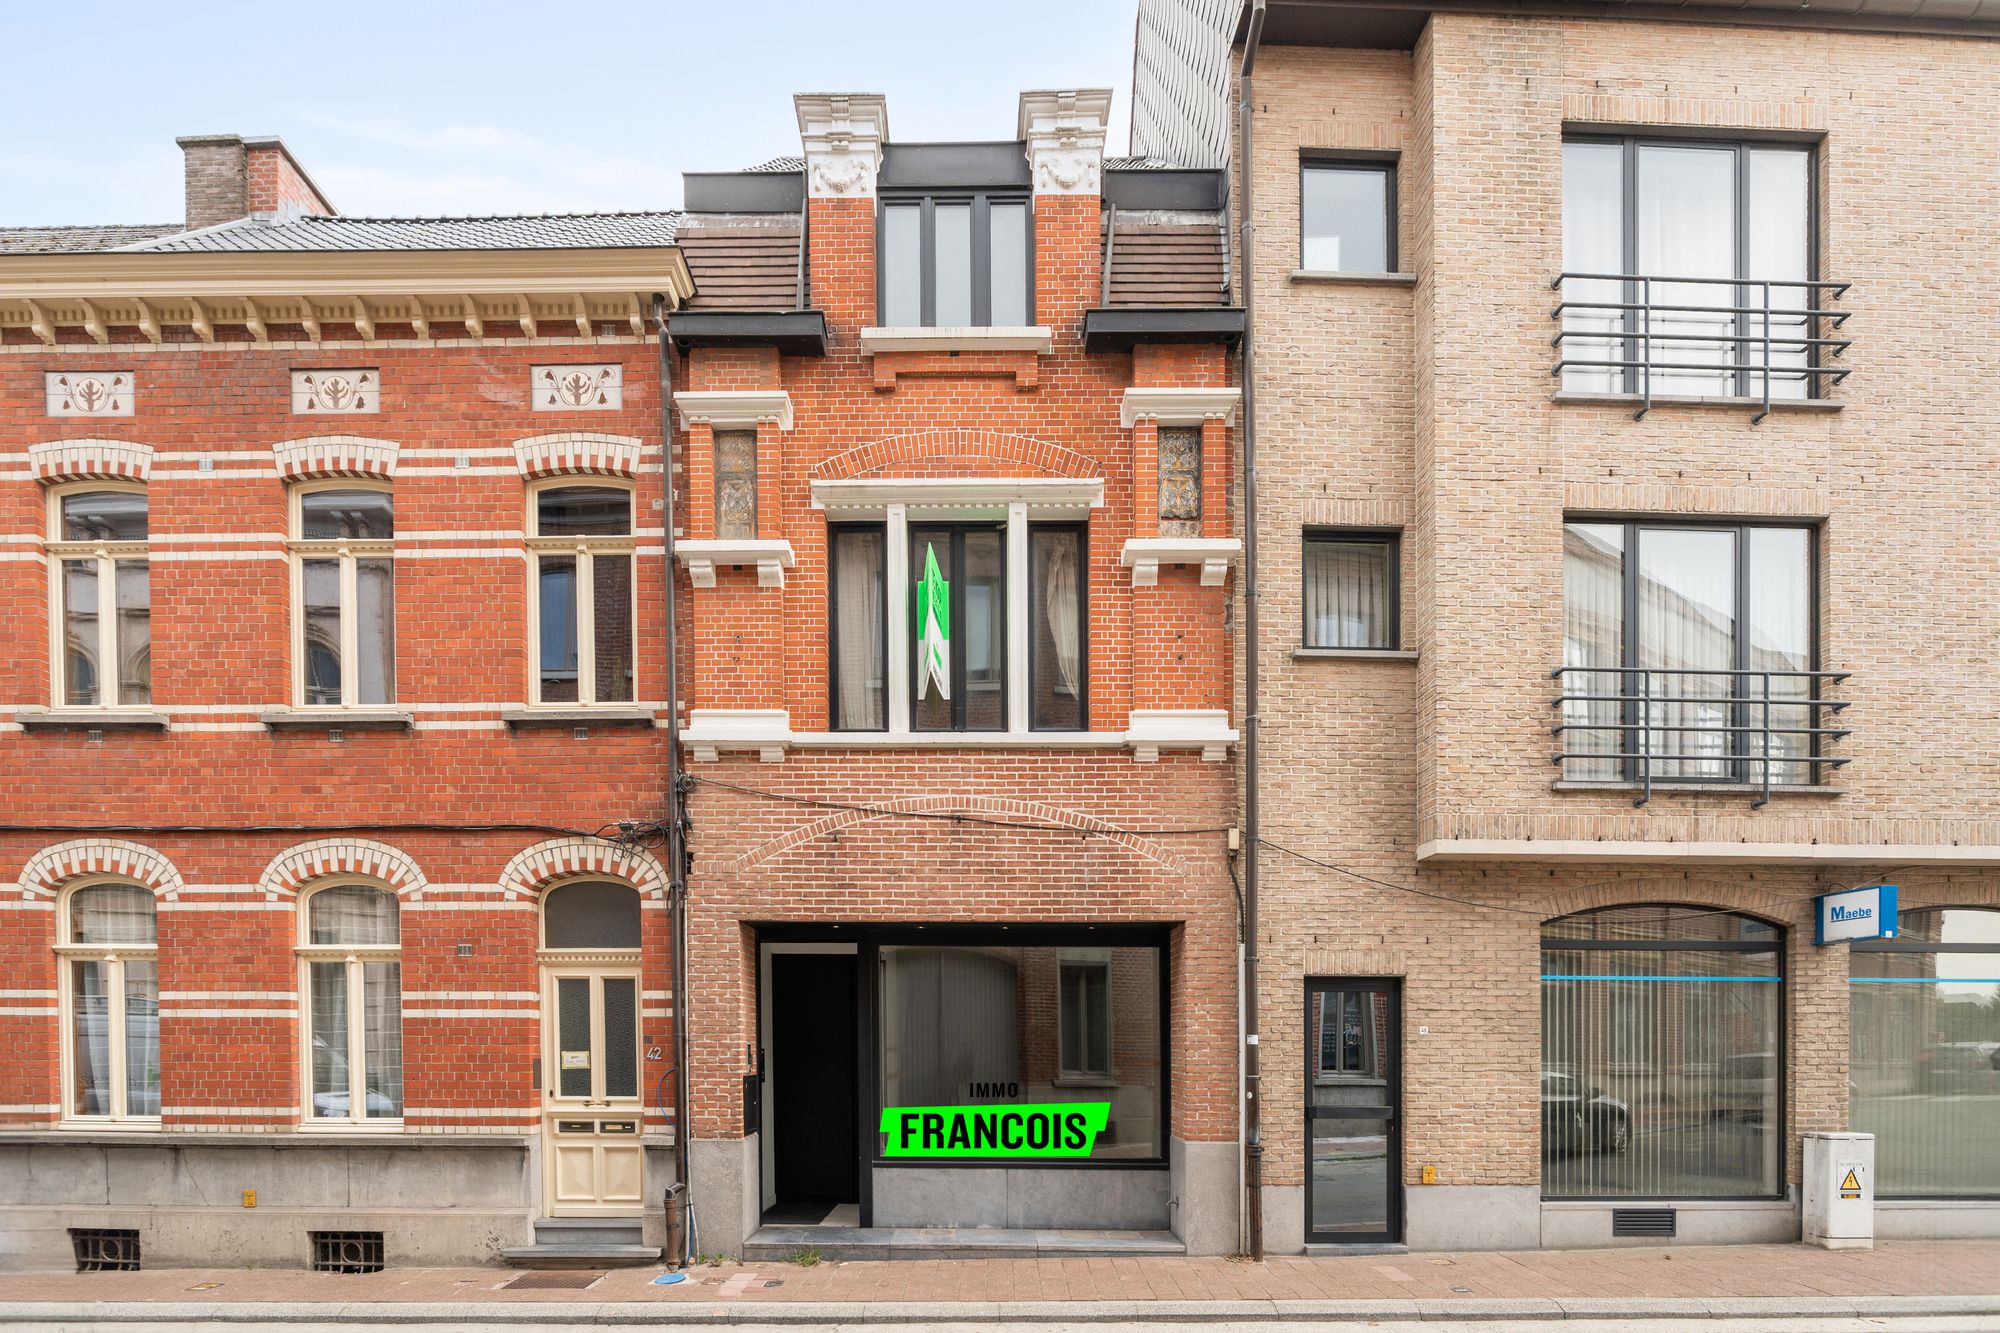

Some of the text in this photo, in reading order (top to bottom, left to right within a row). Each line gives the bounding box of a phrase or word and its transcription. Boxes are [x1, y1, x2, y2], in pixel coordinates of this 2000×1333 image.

[1831, 906, 1872, 920] Maebe
[646, 1047, 662, 1060] 42
[969, 1082, 1018, 1098] IMMO
[900, 1112, 1087, 1150] FRANCOIS
